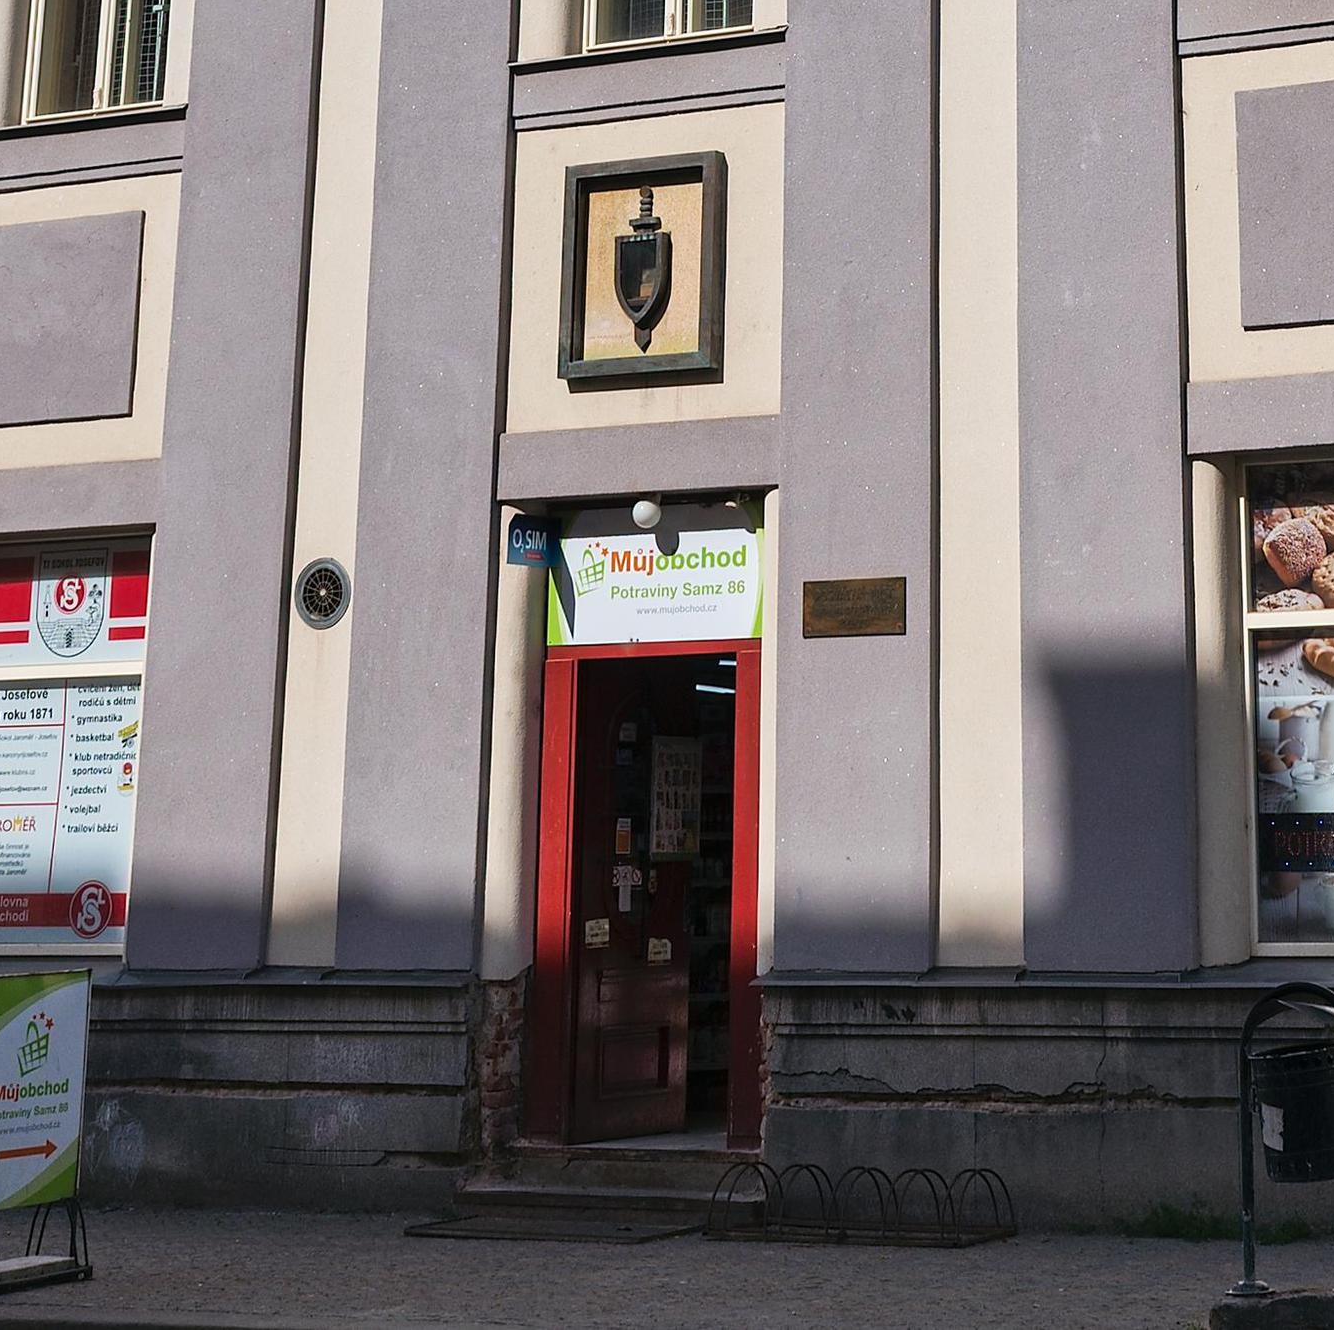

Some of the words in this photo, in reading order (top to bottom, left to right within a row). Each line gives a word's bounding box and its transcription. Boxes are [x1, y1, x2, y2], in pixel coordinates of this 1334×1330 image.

[525, 530, 547, 551] SIM
[611, 545, 746, 576] Můjobchod
[611, 584, 677, 600] Potraviny
[682, 582, 722, 596] Samz
[727, 580, 745, 594] 86
[636, 604, 717, 615] www.mujobchod.cz
[3, 709, 26, 720] roku
[30, 708, 53, 719] 1871
[76, 714, 122, 725] gymnastika
[76, 733, 114, 742] basketbal
[75, 752, 91, 761] klub
[72, 765, 112, 776] sportovců
[70, 785, 107, 796] jezdectví
[70, 804, 101, 815] volejbal
[67, 822, 95, 833] trailoví
[97, 822, 118, 833] běžci
[33, 1105, 57, 1116] Samz
